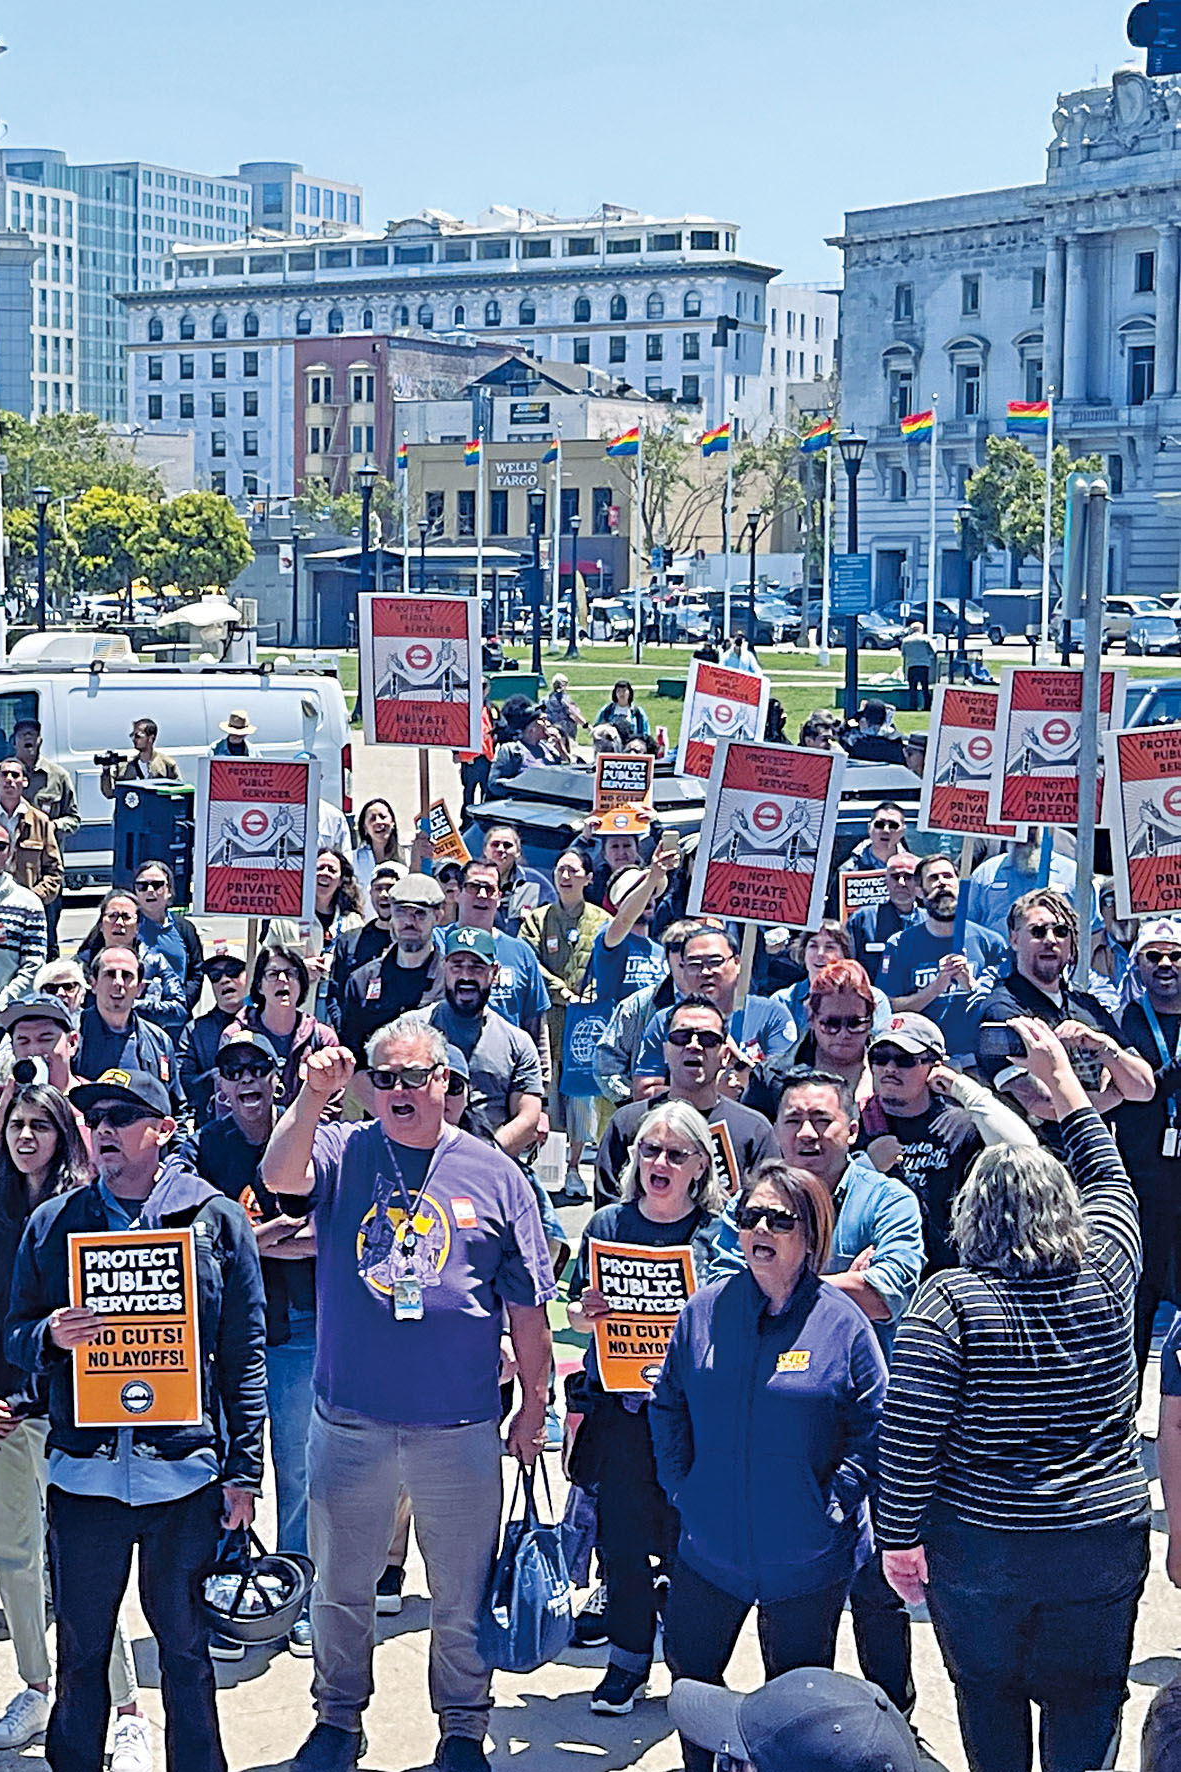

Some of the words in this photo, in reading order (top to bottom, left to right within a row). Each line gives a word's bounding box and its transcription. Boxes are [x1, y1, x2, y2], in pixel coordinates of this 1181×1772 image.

[495, 462, 537, 473] WELLS
[496, 475, 538, 486] FARGO
[1041, 687, 1079, 697] PUBLIC
[228, 768, 274, 778] PROTECT
[603, 770, 646, 780] PUBLIC
[238, 778, 274, 787] PUBLIC
[1042, 781, 1065, 789] NOT
[1025, 791, 1080, 803] PRIVATE
[243, 873, 266, 882] NOT
[749, 871, 772, 882] NOT
[227, 883, 282, 895] PRIVATE
[728, 881, 788, 900] PRIVATE
[229, 896, 278, 907] GREED!
[728, 895, 783, 912] GREED!
[85, 1248, 178, 1270] PROTECT
[600, 1257, 680, 1278] PROTECT
[86, 1269, 180, 1294] PUBLIC
[602, 1275, 684, 1297] PUBLIC
[85, 1293, 183, 1313] SERVICES
[603, 1295, 687, 1313] SERVICES
[607, 1323, 631, 1337] NO
[636, 1324, 676, 1338] CUT
[88, 1330, 115, 1346] NO
[122, 1328, 182, 1345] CUTS!
[608, 1341, 627, 1353] NO
[89, 1351, 108, 1367] NO
[113, 1350, 184, 1367] LAYOFFS!
